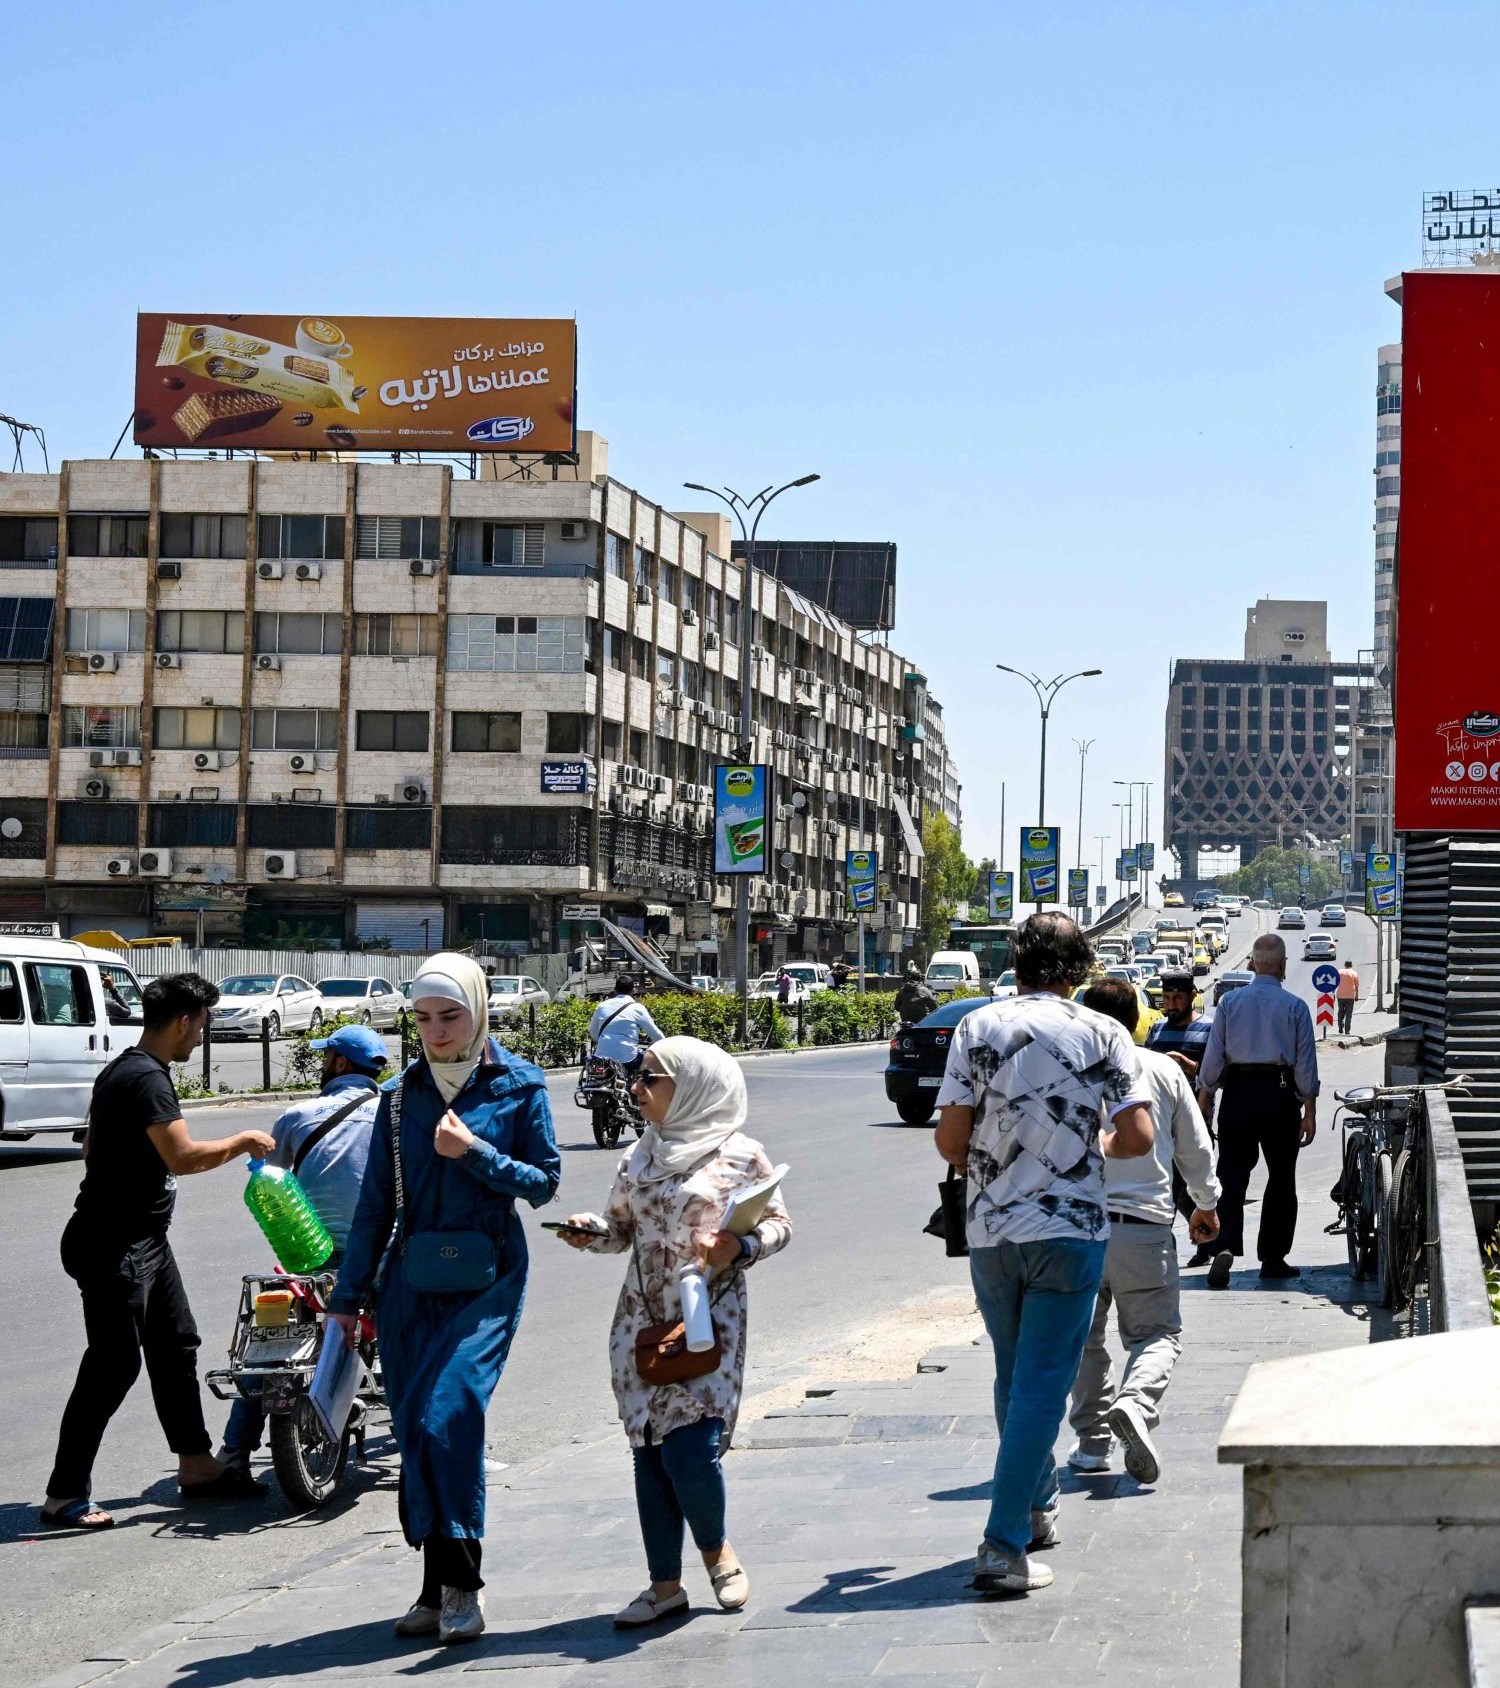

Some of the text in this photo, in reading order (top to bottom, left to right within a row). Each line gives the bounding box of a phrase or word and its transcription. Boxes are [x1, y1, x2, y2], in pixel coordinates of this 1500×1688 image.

[453, 342, 545, 362] مزاجك بركات
[379, 365, 549, 412] عملناها لاتيه
[467, 416, 532, 441] بركات
[1466, 714, 1499, 729] مكي
[1436, 727, 1469, 760] Taste
[543, 763, 584, 775] وكالة حلا
[1431, 787, 1457, 795] MAKKI
[315, 1103, 376, 1116] SPOING
